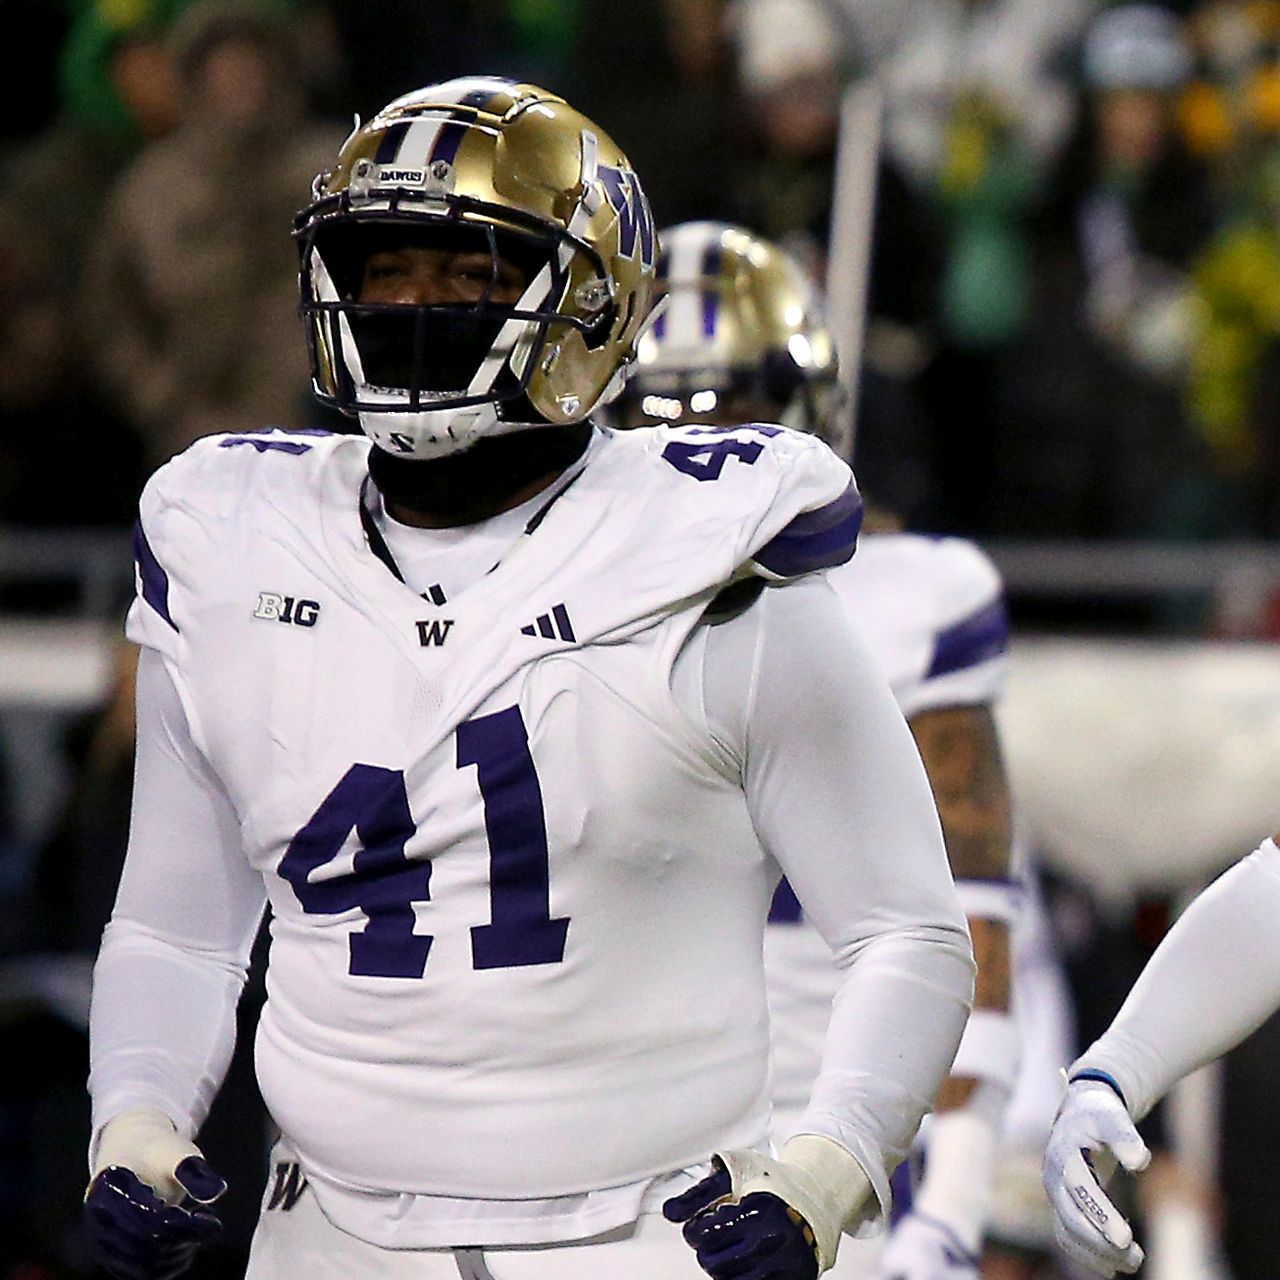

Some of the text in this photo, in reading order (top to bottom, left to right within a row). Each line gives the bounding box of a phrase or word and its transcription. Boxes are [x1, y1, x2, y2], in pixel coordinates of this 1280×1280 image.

[596, 164, 656, 268] W
[415, 620, 454, 647] W
[278, 704, 571, 980] 41
[267, 1163, 308, 1212] W
